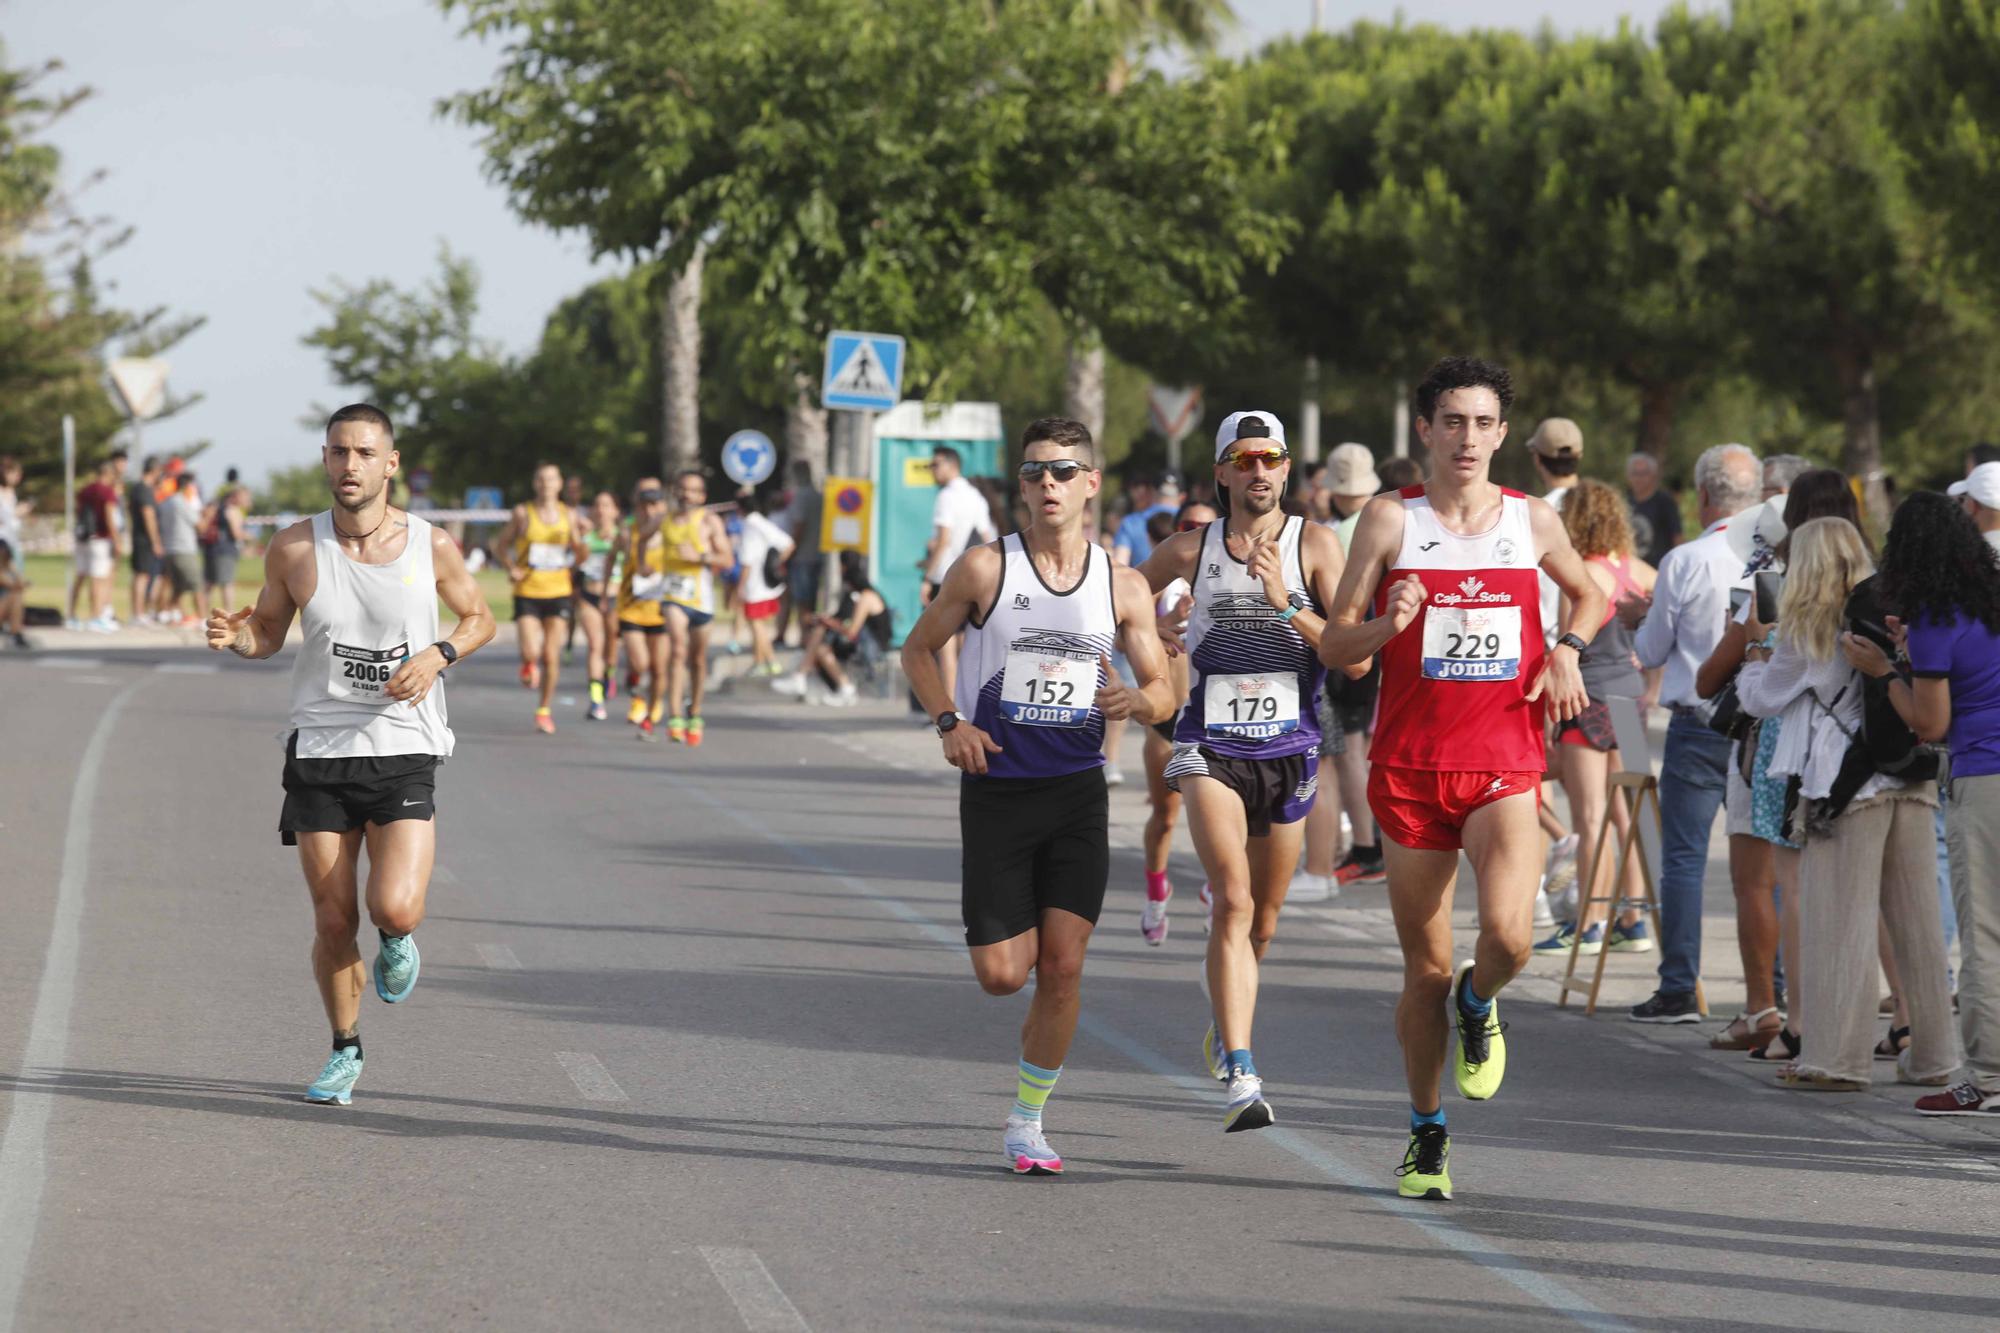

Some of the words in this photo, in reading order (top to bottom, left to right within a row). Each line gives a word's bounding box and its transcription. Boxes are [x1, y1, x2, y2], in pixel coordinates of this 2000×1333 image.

[1434, 593, 1462, 605] Caja
[1479, 592, 1512, 603] Soria
[1221, 621, 1274, 630] SORIA
[1446, 633, 1500, 658] 229
[344, 661, 390, 682] 2006
[1025, 679, 1074, 705] 152
[1227, 697, 1277, 721] 179
